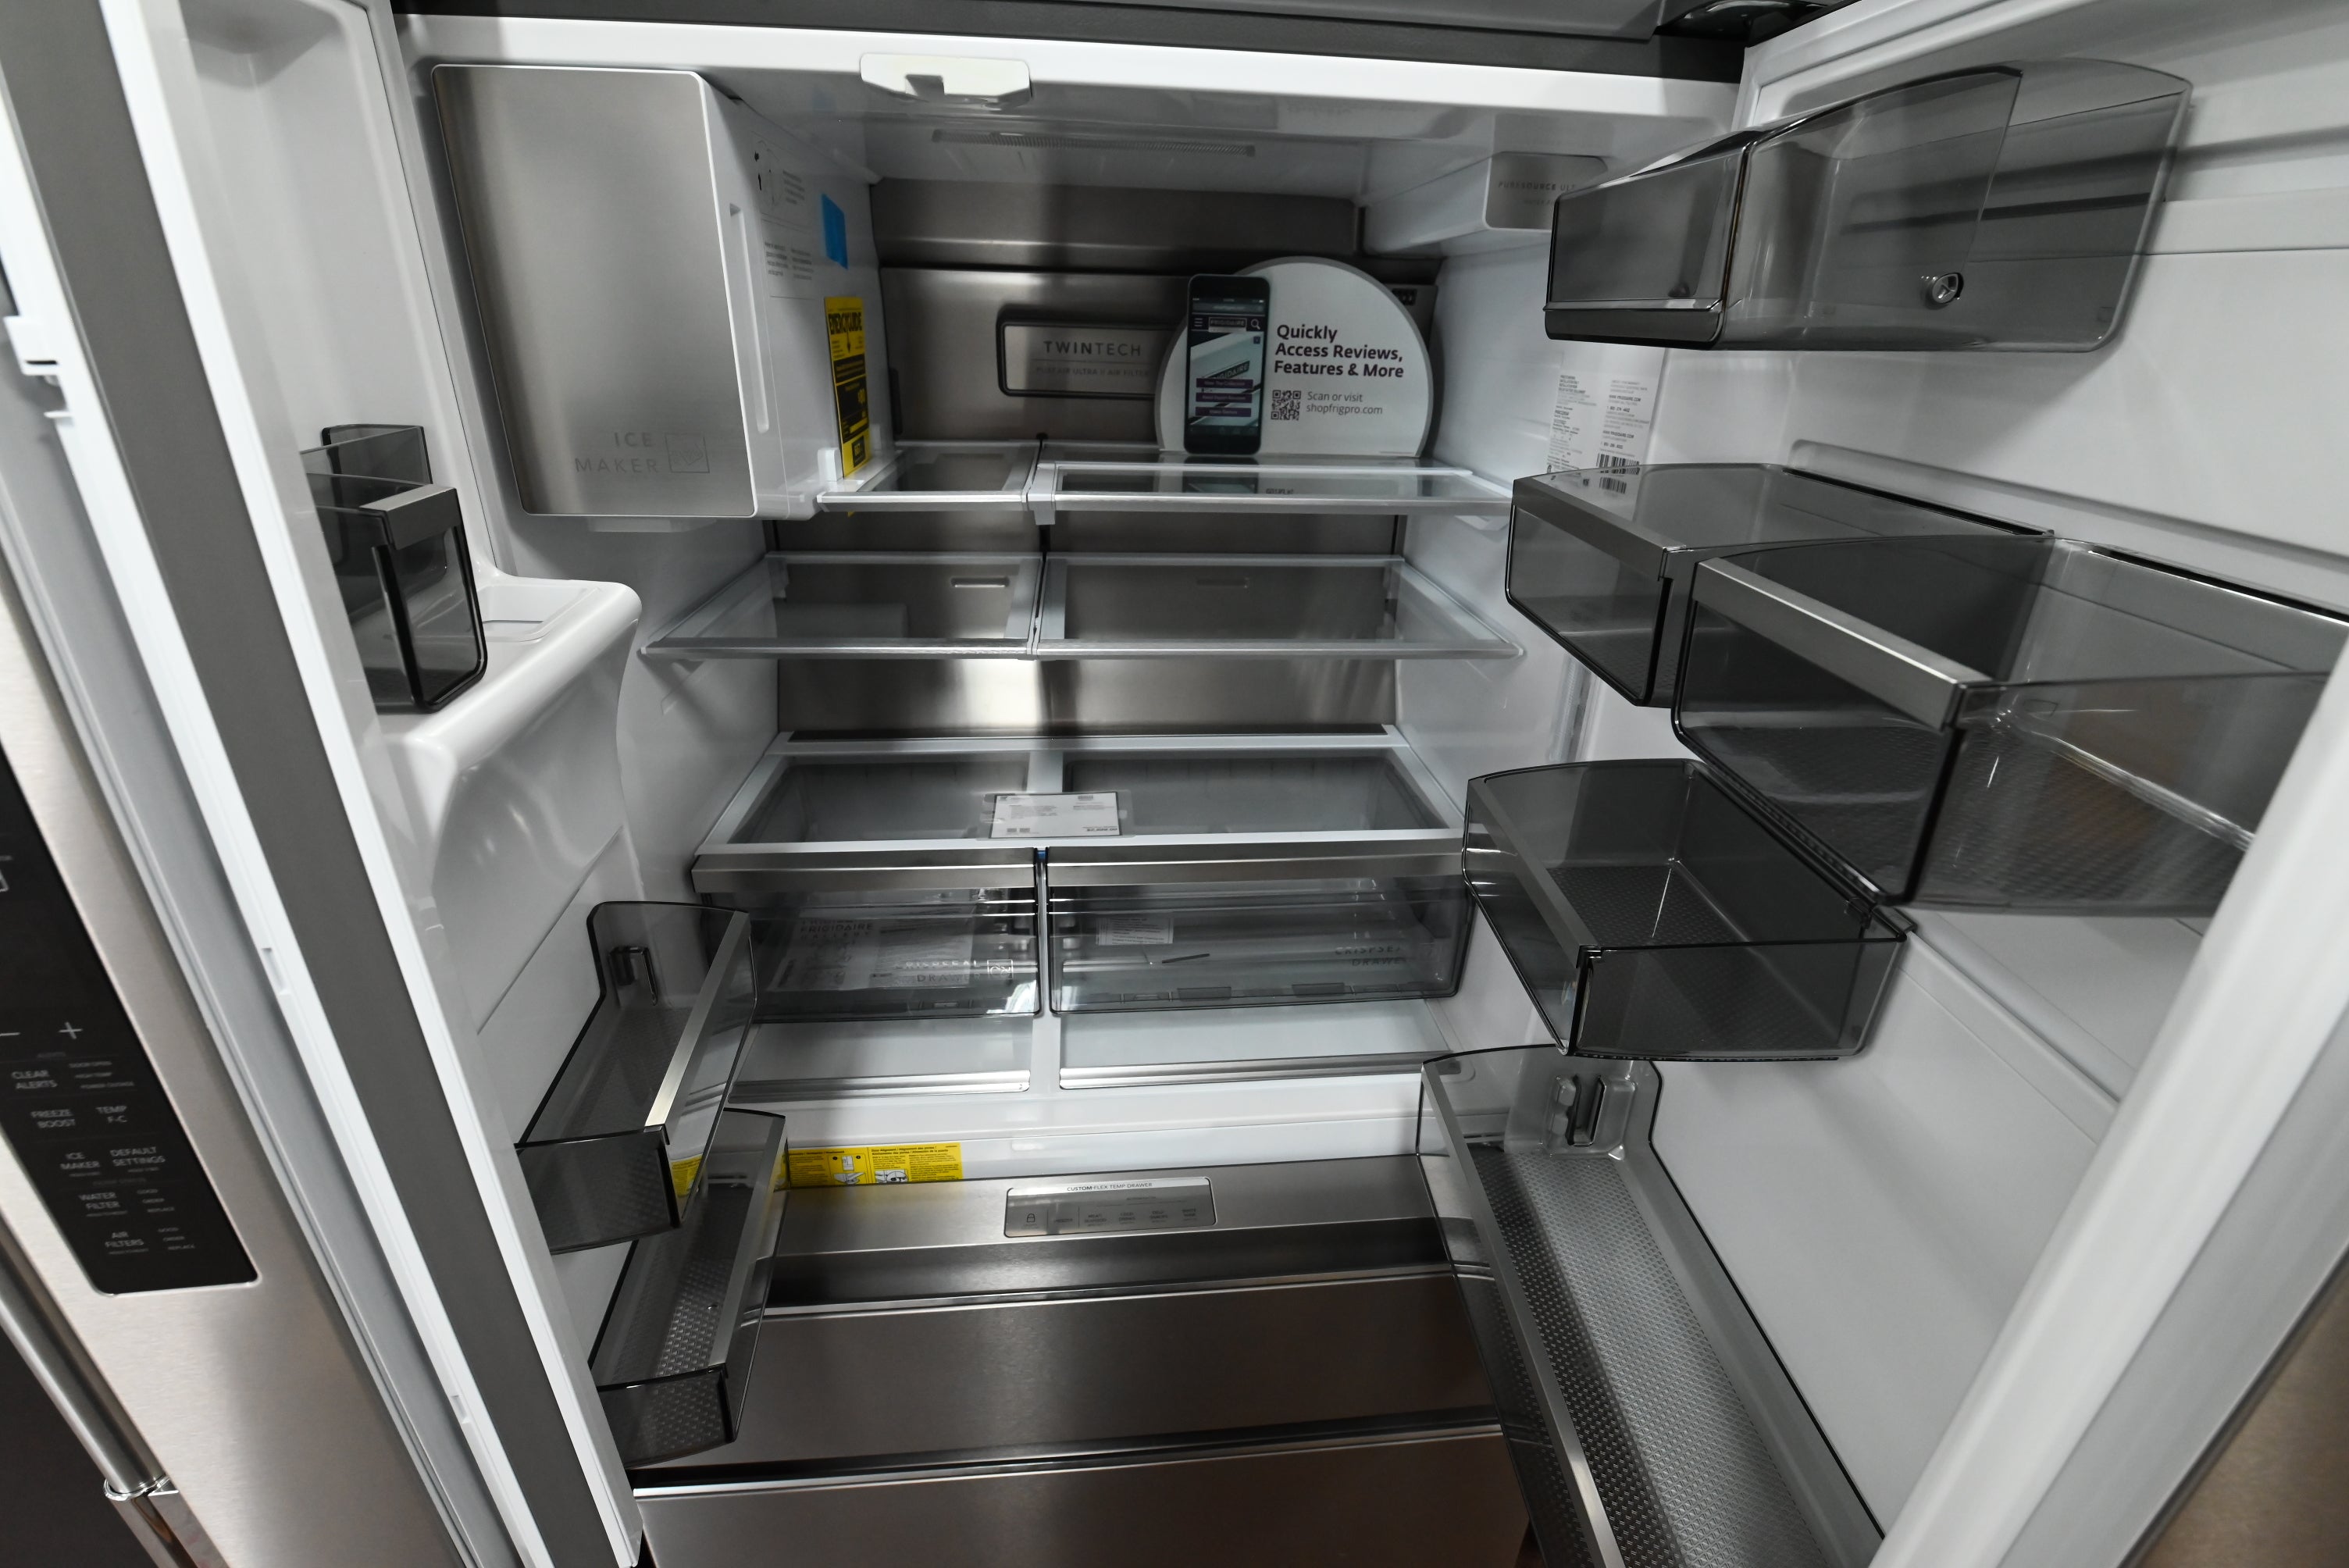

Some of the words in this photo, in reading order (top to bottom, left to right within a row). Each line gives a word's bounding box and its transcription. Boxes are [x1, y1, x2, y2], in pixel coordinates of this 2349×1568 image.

[1276, 323, 1338, 344] Quickly
[1043, 340, 1141, 357] TWINTECH
[1274, 342, 1329, 358] Access
[1332, 344, 1403, 362] Reviews,
[1274, 359, 1344, 376] Features
[1347, 362, 1360, 376] &
[1363, 363, 1405, 378] More
[1306, 390, 1330, 402] Scan
[1331, 393, 1342, 402] or
[1344, 392, 1363, 403] visit
[1306, 403, 1383, 416] shopfrigpro.com
[613, 431, 653, 447] ICE
[574, 458, 658, 473] MAKER
[800, 922, 874, 934] FRIGIDAIRE
[12, 1070, 48, 1079] CLEAR
[16, 1080, 57, 1089] ALERTS
[30, 1110, 73, 1119] FREEZE
[96, 1106, 127, 1114] TEMP
[38, 1119, 75, 1128] BOOST
[110, 1146, 156, 1156] DEFAULT
[66, 1152, 86, 1161] ICE
[112, 1156, 166, 1167] SETTINGS
[61, 1161, 100, 1171] MAKER
[80, 1192, 116, 1201] WATER
[86, 1201, 119, 1210] FILTER
[105, 1239, 144, 1248] FILTERS
